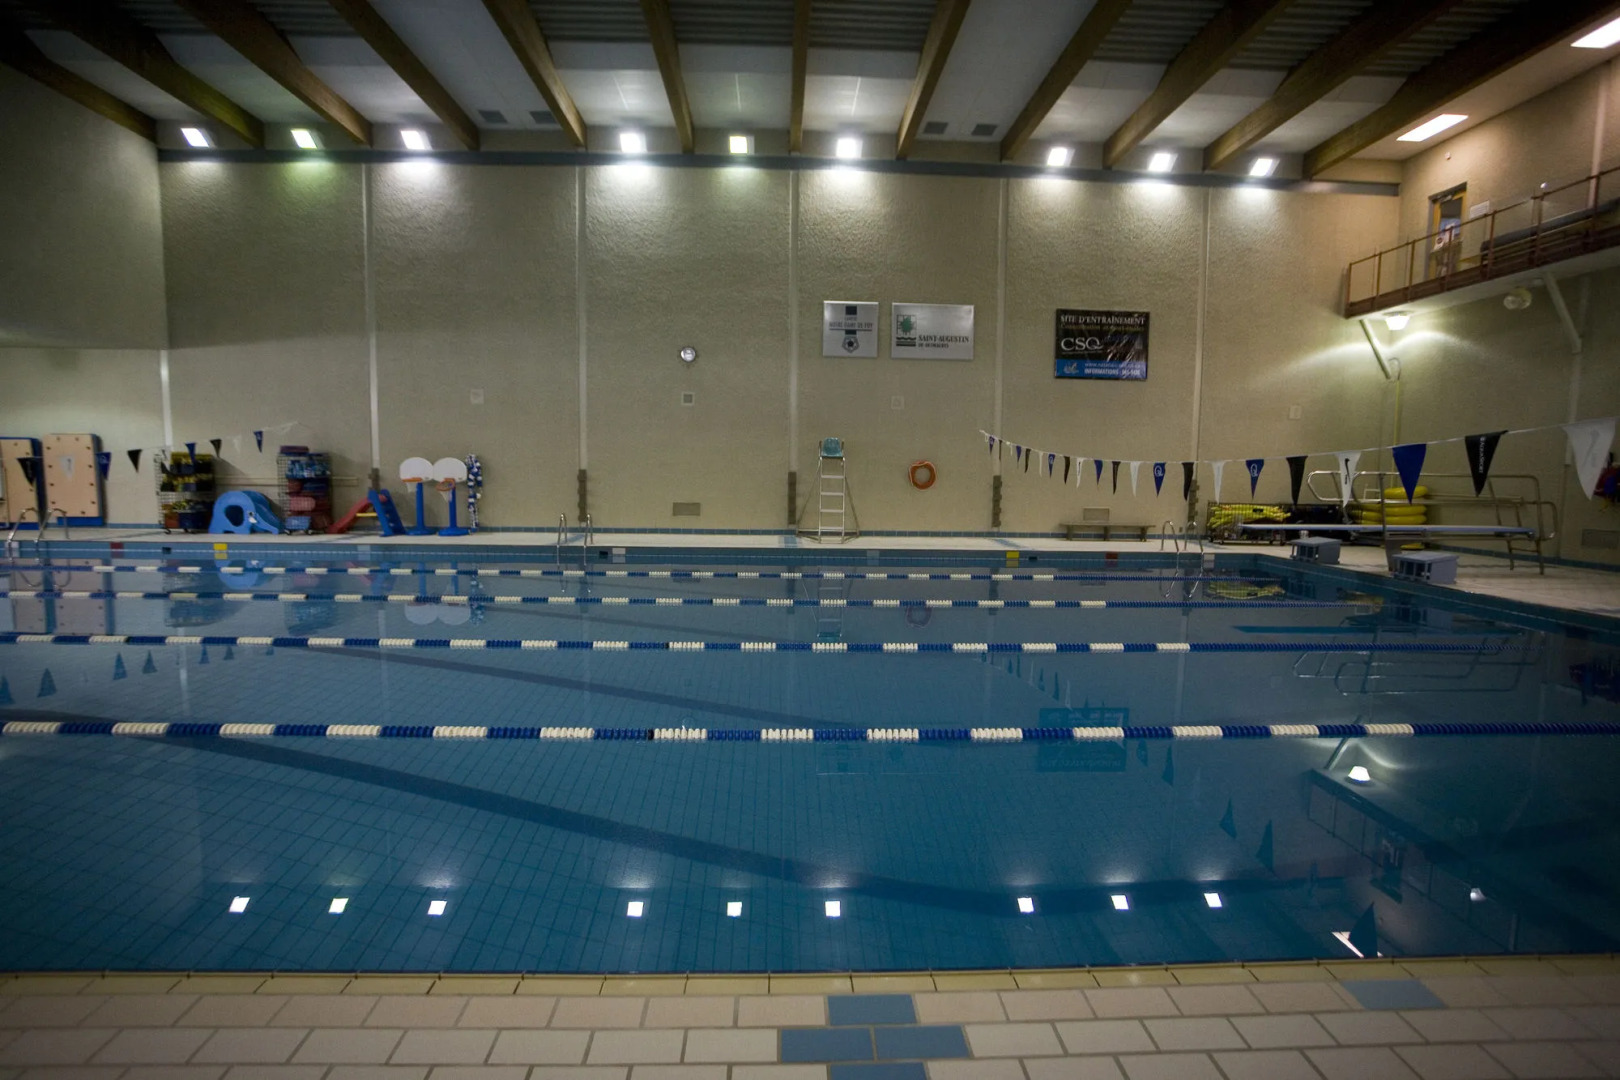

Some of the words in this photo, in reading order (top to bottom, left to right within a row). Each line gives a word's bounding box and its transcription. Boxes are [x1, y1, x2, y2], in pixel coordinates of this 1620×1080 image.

[1060, 314, 1076, 323] SITE
[1079, 315, 1145, 325] D'ENTRAÎNEMENT
[918, 335, 969, 343] SAINT-AUGUSTIN
[1061, 336, 1104, 351] CSQ
